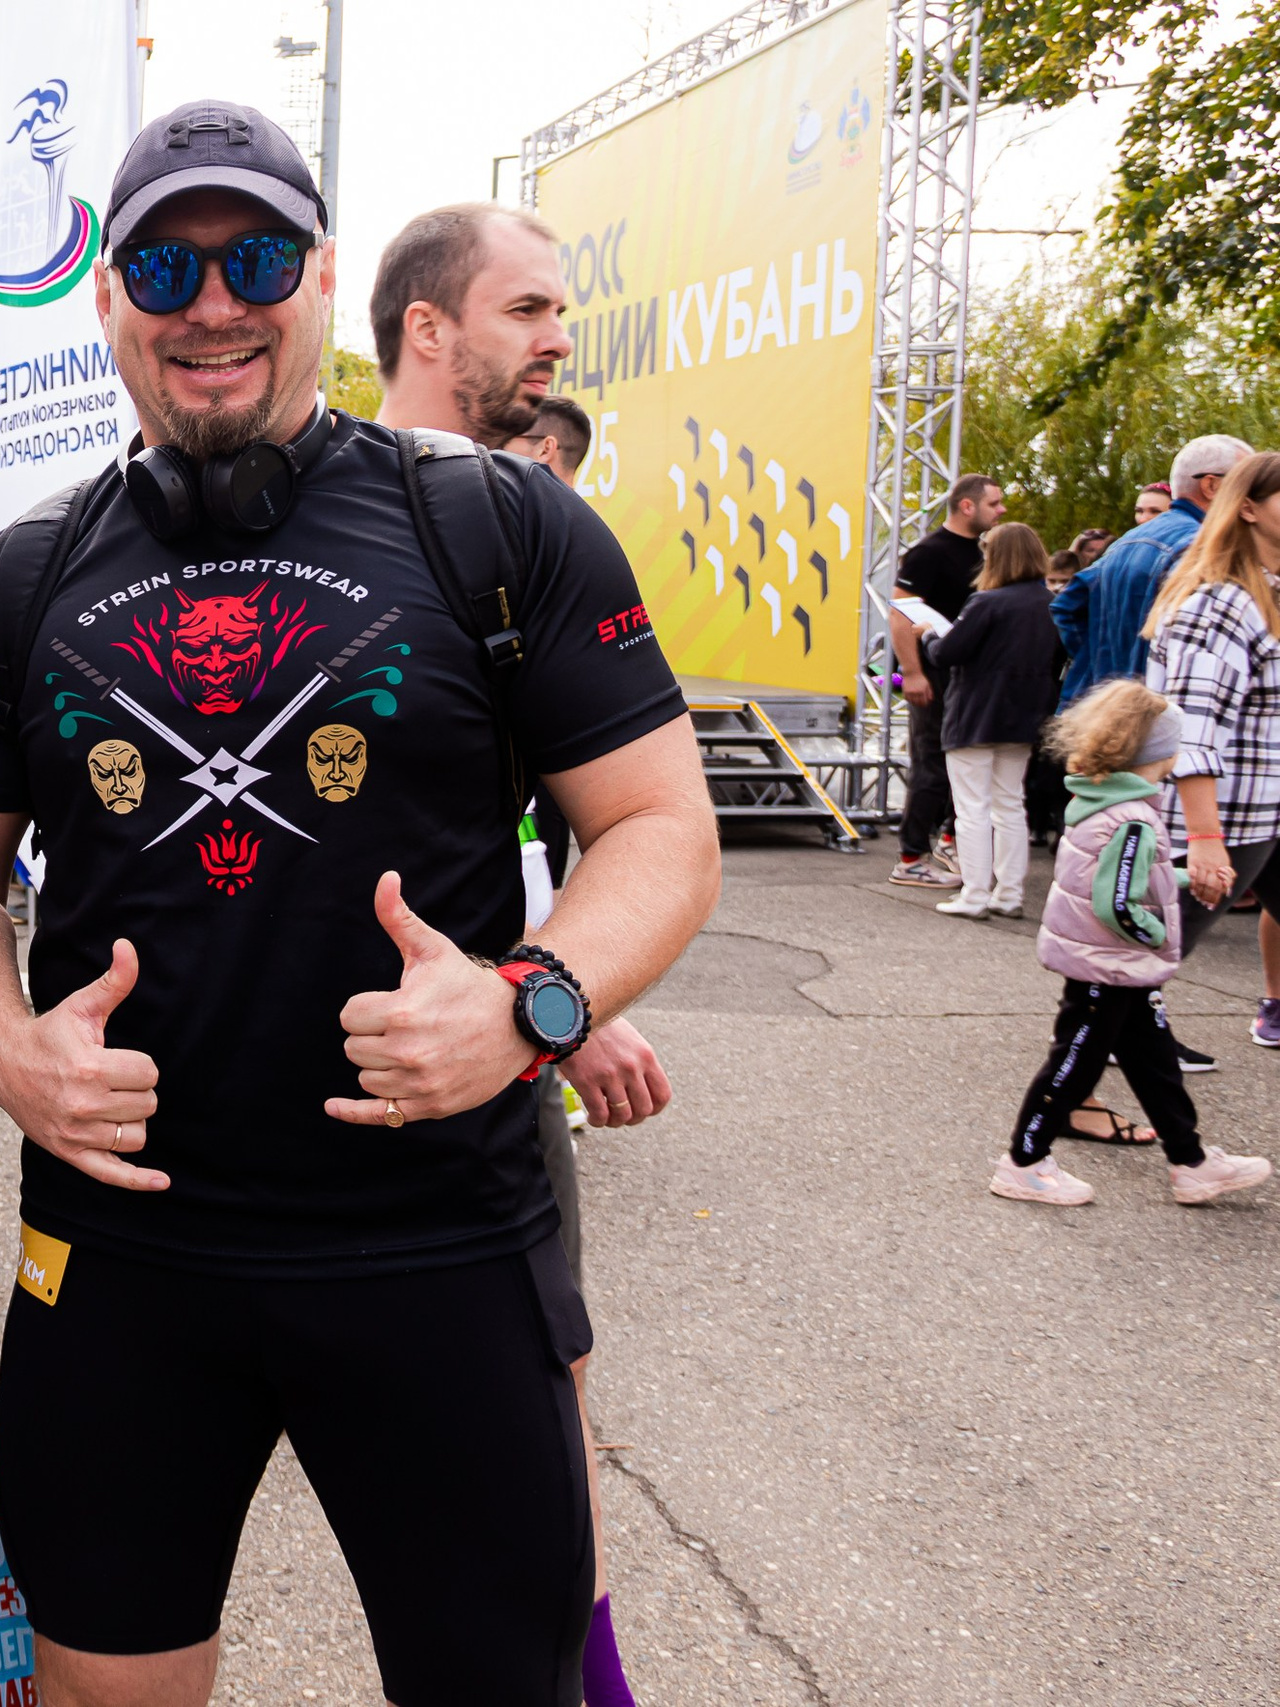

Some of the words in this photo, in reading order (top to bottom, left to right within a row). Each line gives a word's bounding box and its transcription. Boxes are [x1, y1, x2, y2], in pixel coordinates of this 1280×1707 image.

[551, 296, 658, 401] АЦИИ
[665, 238, 864, 371] КУБАНЬ
[77, 572, 171, 627] STREIN
[182, 558, 369, 603] SPORTSWEAR
